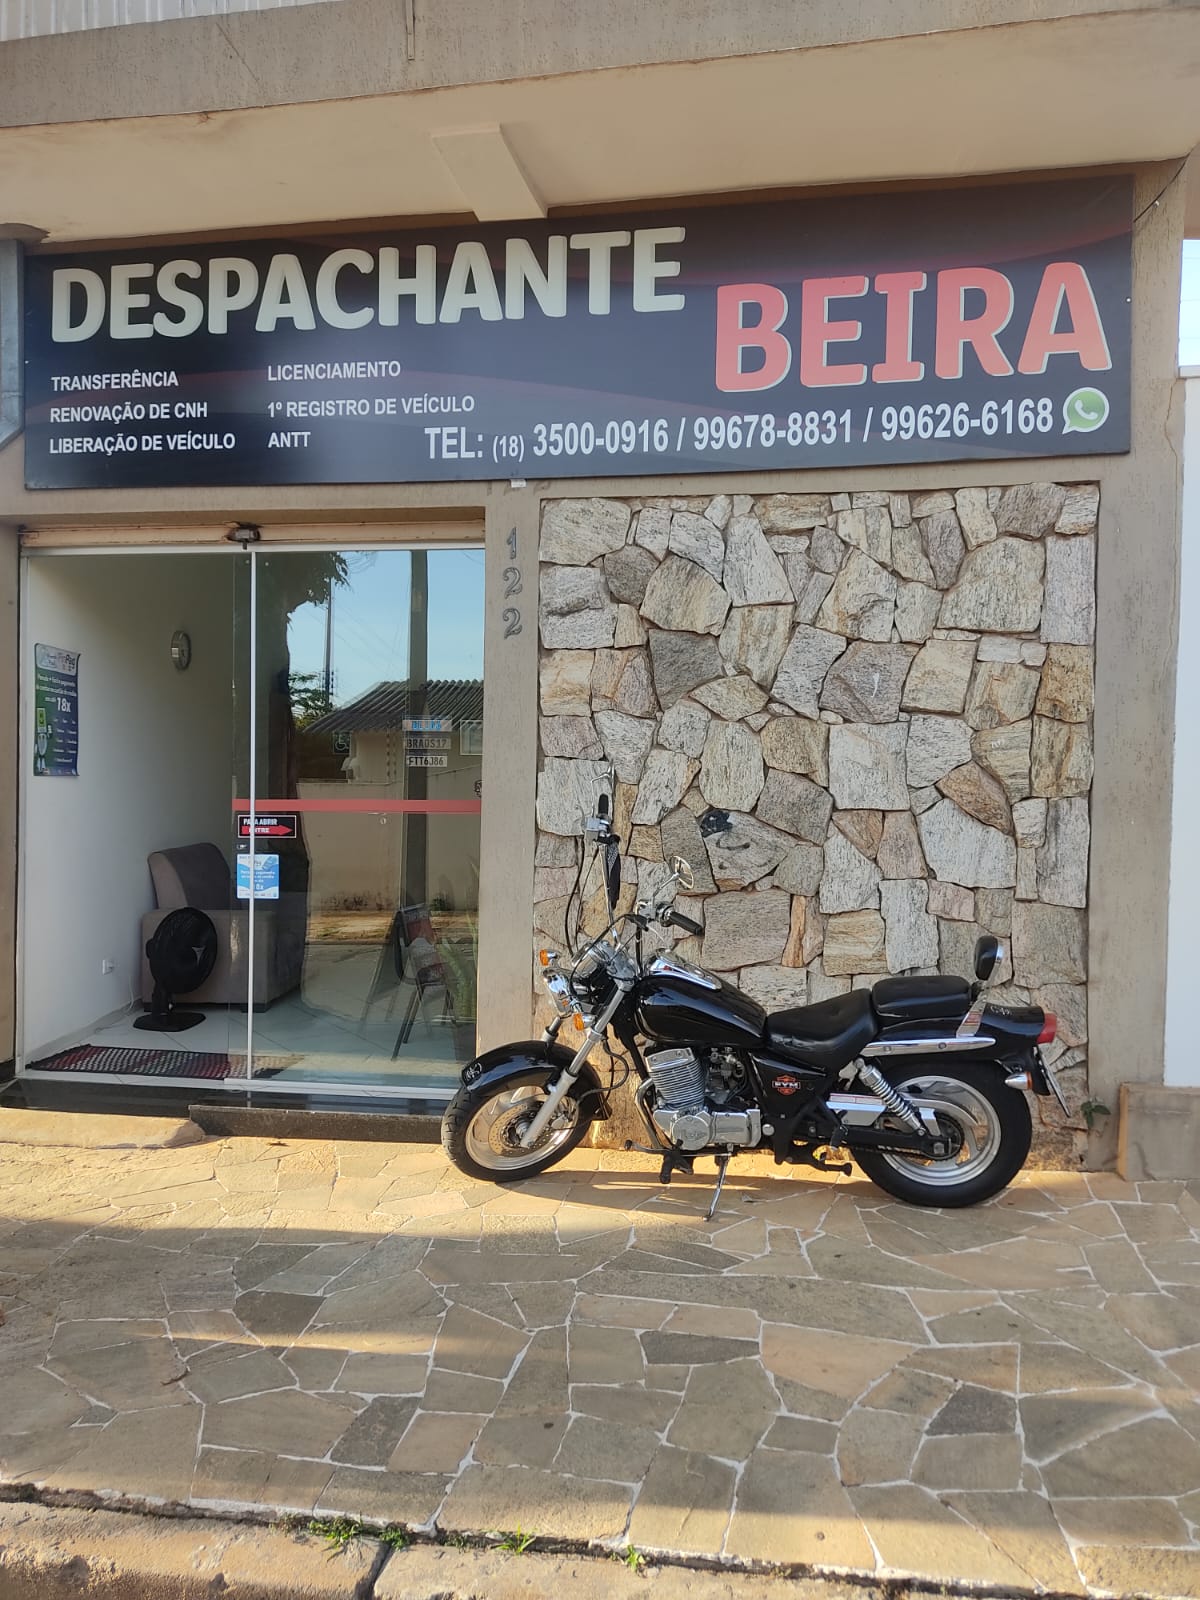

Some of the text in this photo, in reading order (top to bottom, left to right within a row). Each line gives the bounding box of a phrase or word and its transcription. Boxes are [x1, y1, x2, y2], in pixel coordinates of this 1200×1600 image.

[51, 227, 686, 343] DESPACHANTE
[714, 262, 1112, 393] BEIRA
[51, 370, 179, 391] TRANSFERÊNCIA
[267, 360, 401, 382] LICENCIAMENTO
[50, 401, 208, 426] RENOVAÇÃO DE CNH
[286, 398, 371, 417] REGISTRO
[375, 398, 397, 415] DE
[401, 393, 475, 414] VEÍCULO
[268, 432, 311, 449] ANTT
[424, 397, 1054, 463] TEL: (18) 3500-0916 / 99678-8831 / 99626-6168
[49, 432, 236, 455] LIBERAÇÃO DE VEÍCULO
[57, 698, 71, 712] 18x
